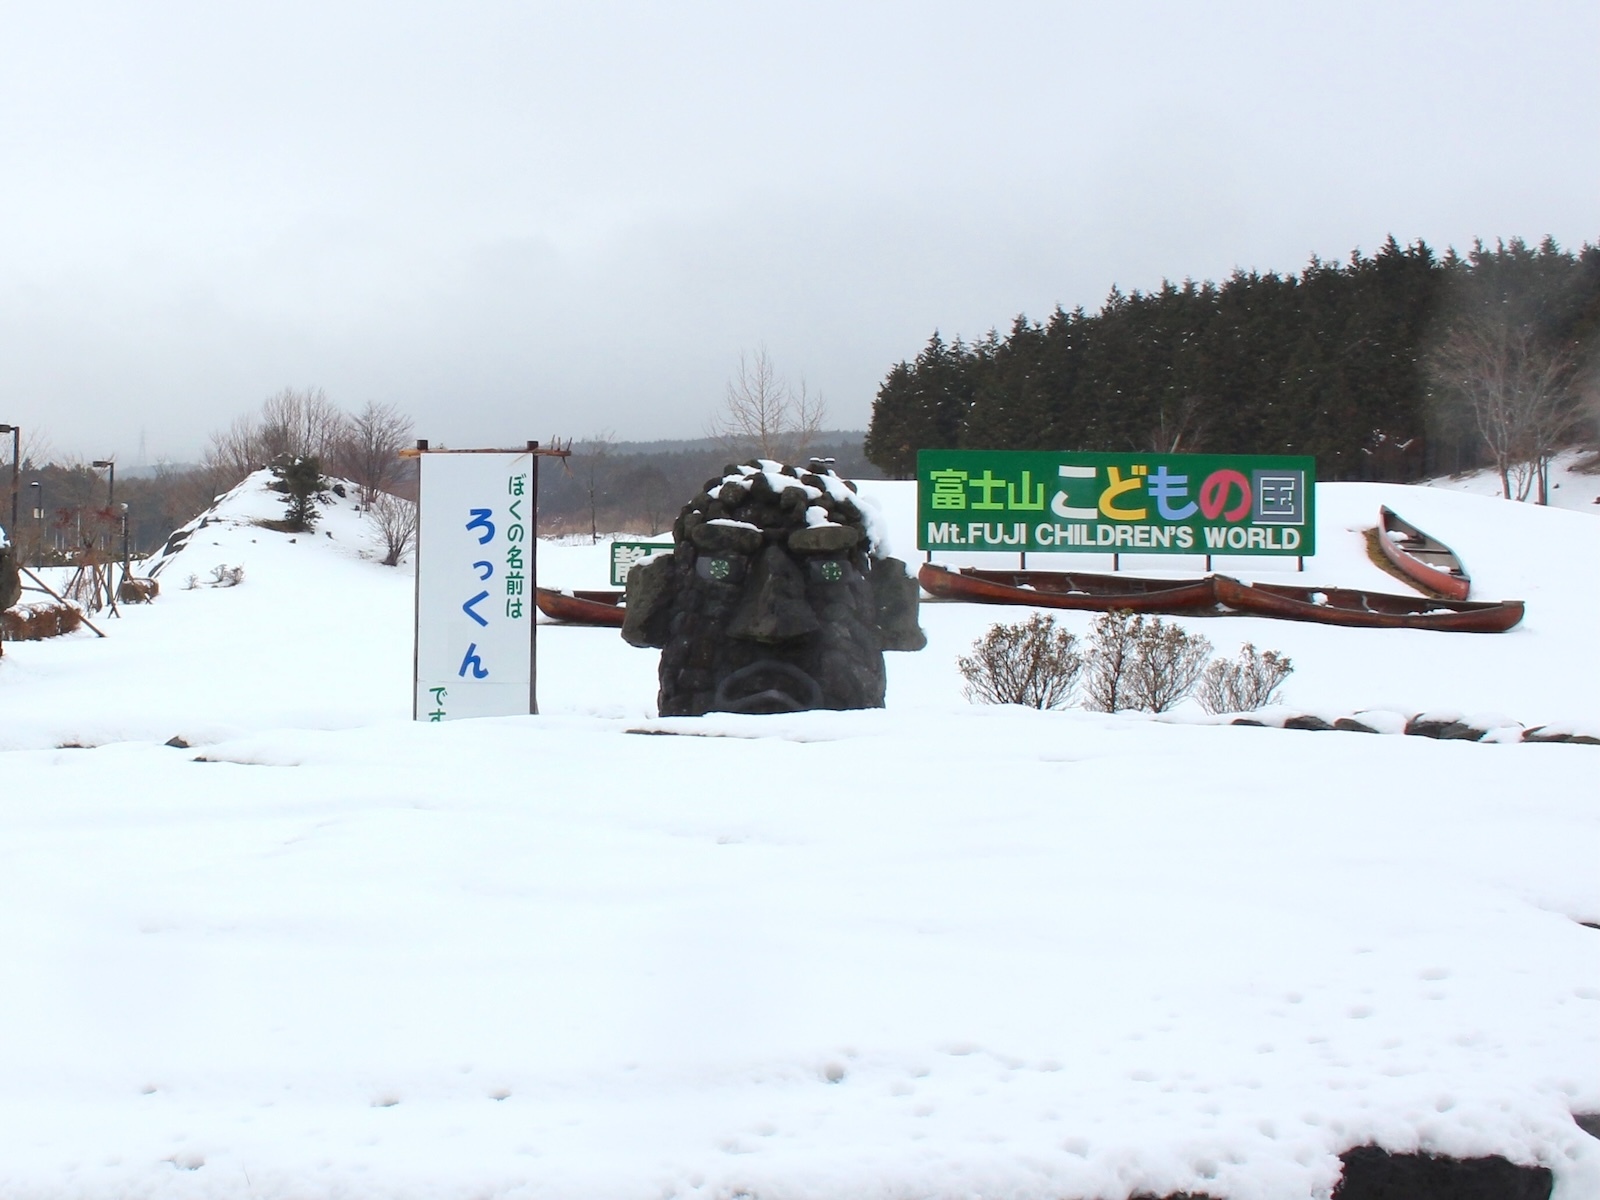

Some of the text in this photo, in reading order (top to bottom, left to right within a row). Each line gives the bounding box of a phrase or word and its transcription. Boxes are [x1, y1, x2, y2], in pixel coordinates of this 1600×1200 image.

[505, 473, 527, 619] ぼくの名前は
[927, 522, 1300, 550] Mt.FUJI CHILDREN'S WORLD
[930, 464, 1304, 525] 富士山こどもの国
[457, 508, 496, 679] ろっくん
